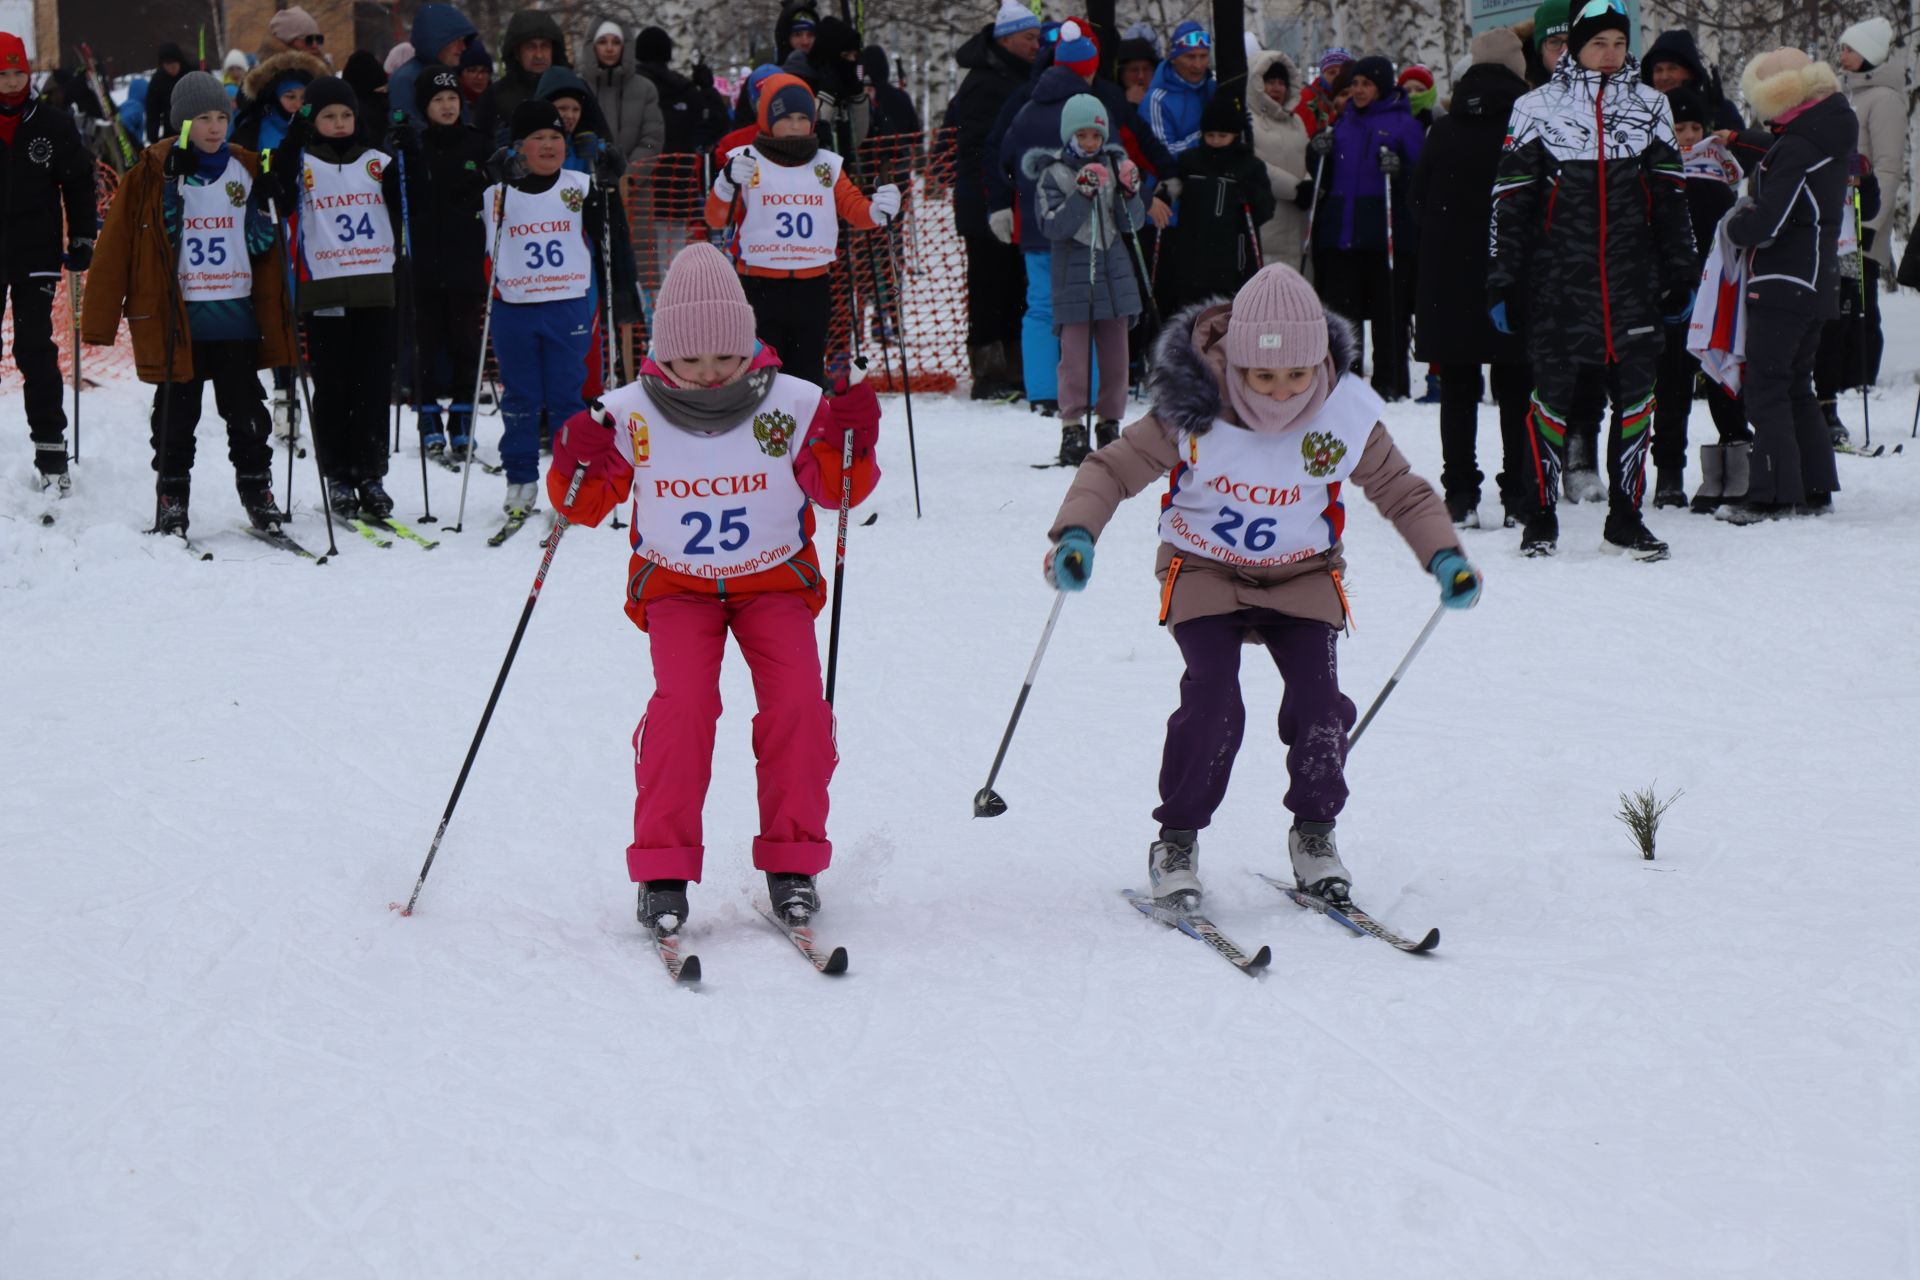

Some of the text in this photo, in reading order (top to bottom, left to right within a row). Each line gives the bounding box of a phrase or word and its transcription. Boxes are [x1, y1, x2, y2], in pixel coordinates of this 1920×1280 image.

[306, 192, 386, 212] ТАТАРСТА
[762, 193, 824, 206] РОССИЯ
[183, 215, 235, 230] ОССИЯ
[335, 212, 376, 242] 34
[509, 220, 571, 238] РОССИЯ
[775, 211, 813, 239] 30
[186, 236, 227, 266] 35
[523, 239, 565, 270] 36
[654, 472, 768, 499] РОССИЯ
[680, 506, 750, 555] 25
[1211, 505, 1278, 552] 26
[696, 543, 792, 578] «Премьер-Сити»
